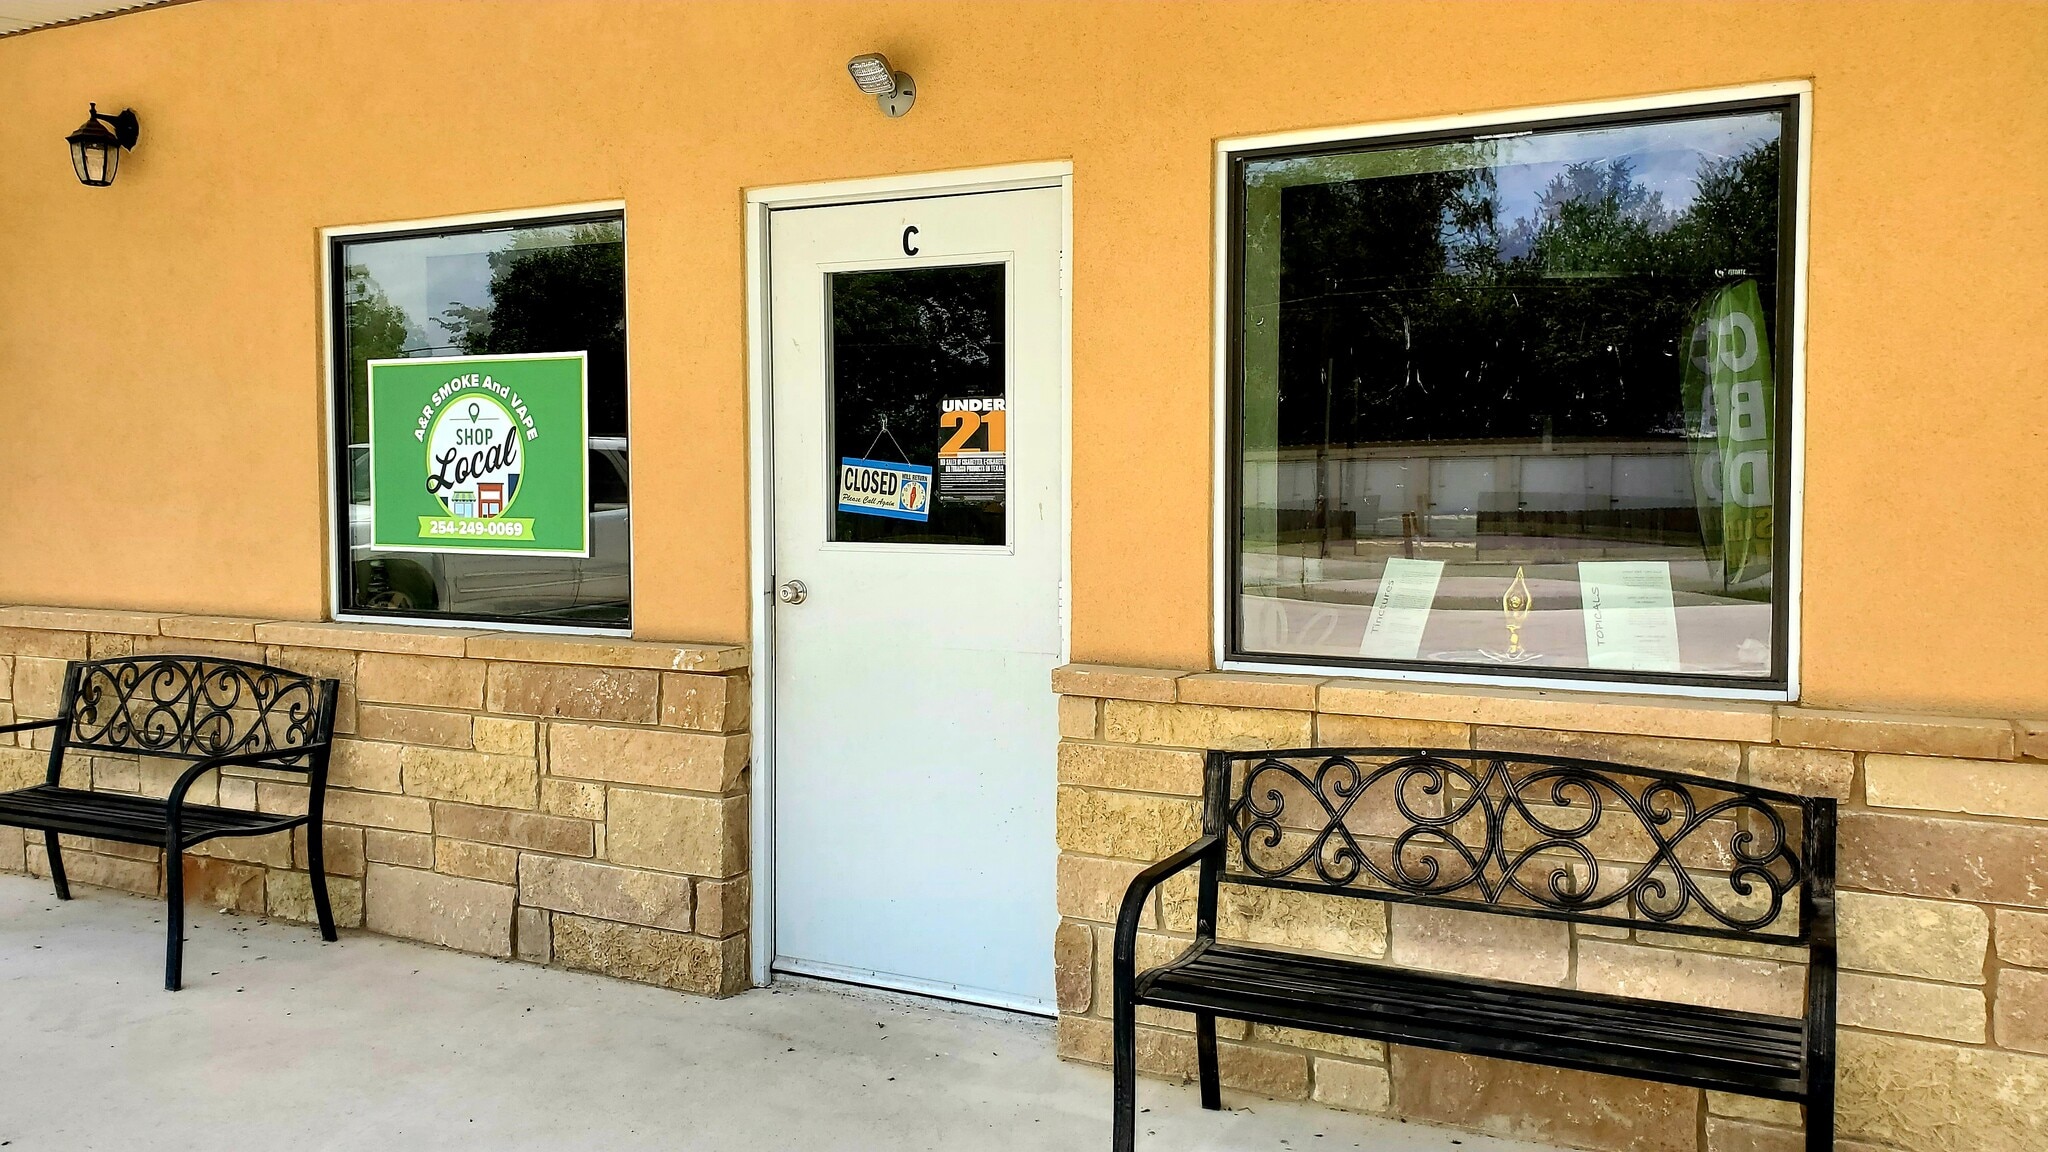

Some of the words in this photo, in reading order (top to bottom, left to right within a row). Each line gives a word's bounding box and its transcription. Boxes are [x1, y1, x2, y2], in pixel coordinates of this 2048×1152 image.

[902, 225, 920, 257] C
[414, 404, 435, 443] A&R
[431, 373, 480, 407] SMOKE
[482, 375, 511, 399] And
[509, 393, 540, 442] VAPE
[941, 398, 1006, 413] UNDER
[455, 428, 494, 446] SHOP
[940, 410, 1006, 452] 21
[426, 425, 517, 495] Local
[844, 467, 898, 495] CLOSED
[842, 493, 861, 503] Please
[862, 495, 877, 505] Call
[876, 498, 895, 508] Again
[429, 520, 523, 536] 254-249-0069
[1371, 579, 1395, 634] Tinctures
[1591, 586, 1606, 647] TOPICALS
